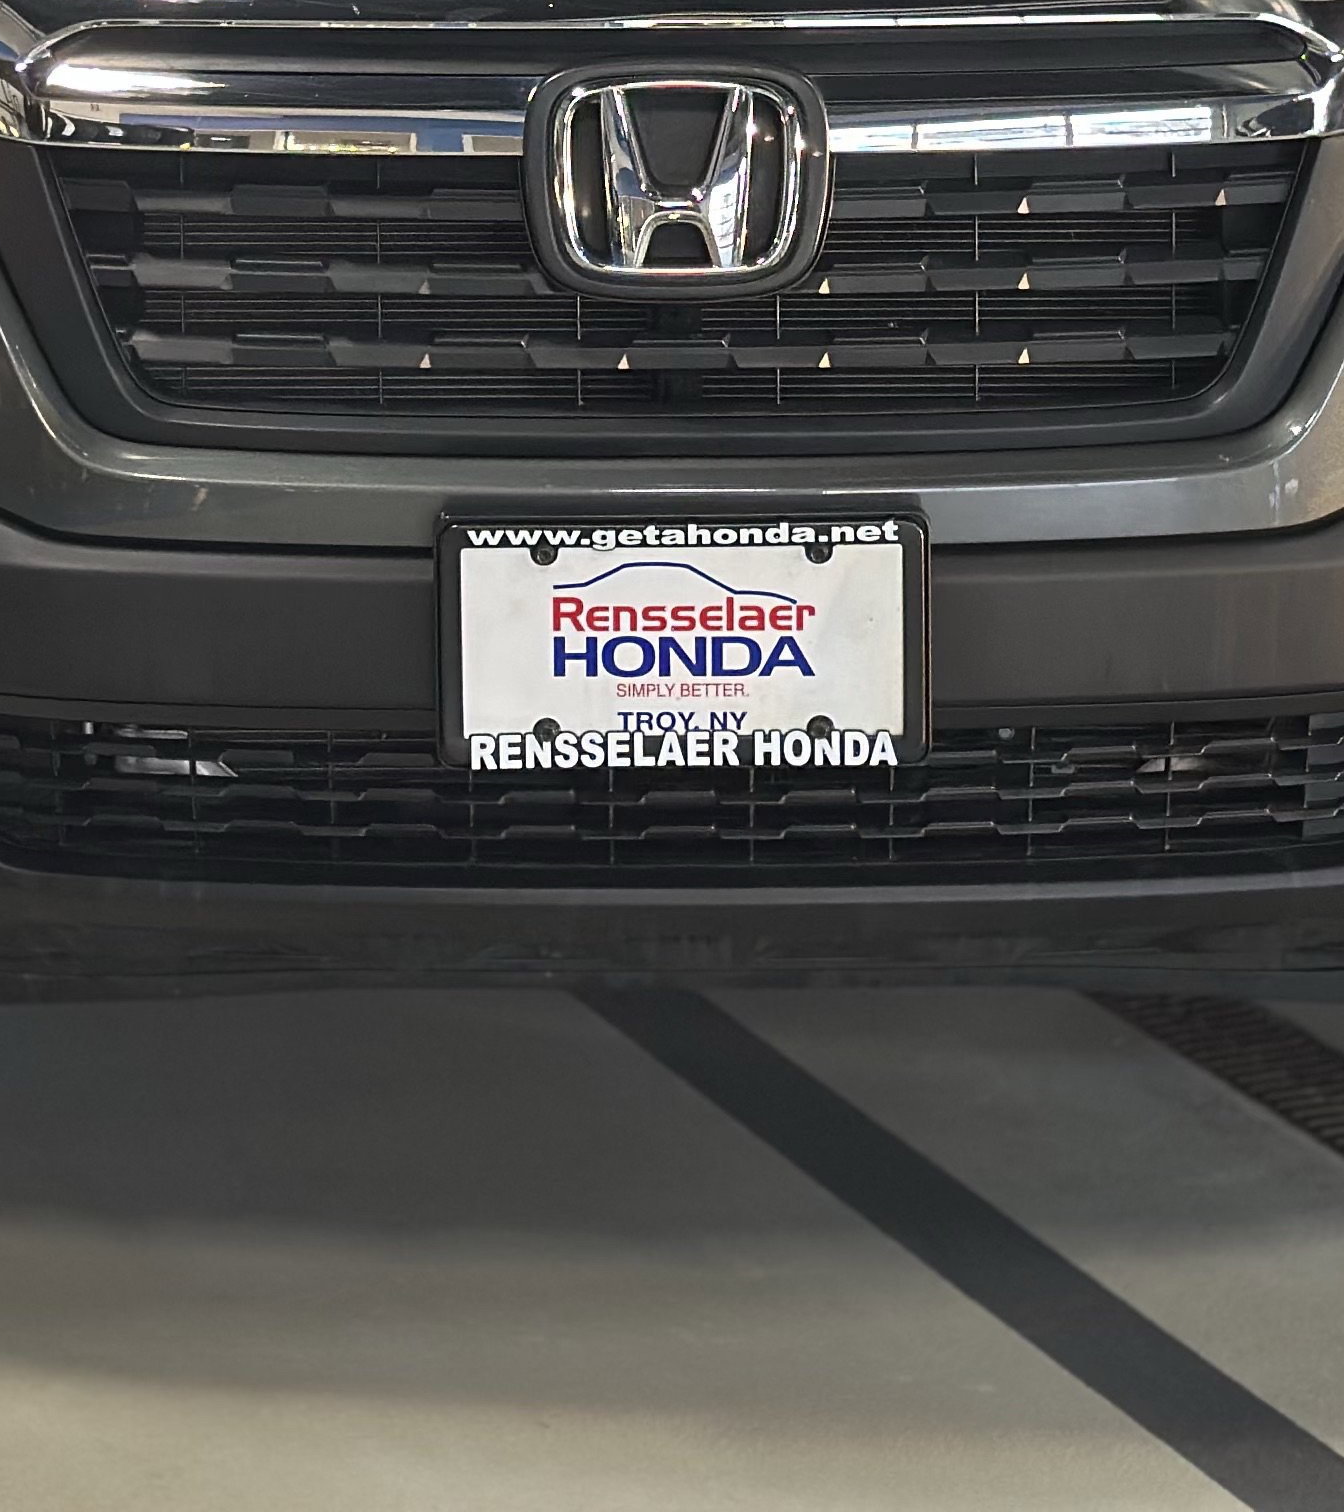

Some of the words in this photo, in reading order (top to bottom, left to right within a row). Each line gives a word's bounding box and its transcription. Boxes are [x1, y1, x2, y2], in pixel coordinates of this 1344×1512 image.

[467, 521, 900, 550] www.getahonda.net
[552, 596, 816, 632] Rensselaer
[553, 635, 816, 678] HONDA
[616, 683, 676, 698] SIMPLY
[680, 683, 750, 698] BETTER.
[710, 711, 749, 731] NY
[470, 731, 740, 770] RENSSELAER
[753, 729, 900, 768] HONDA
